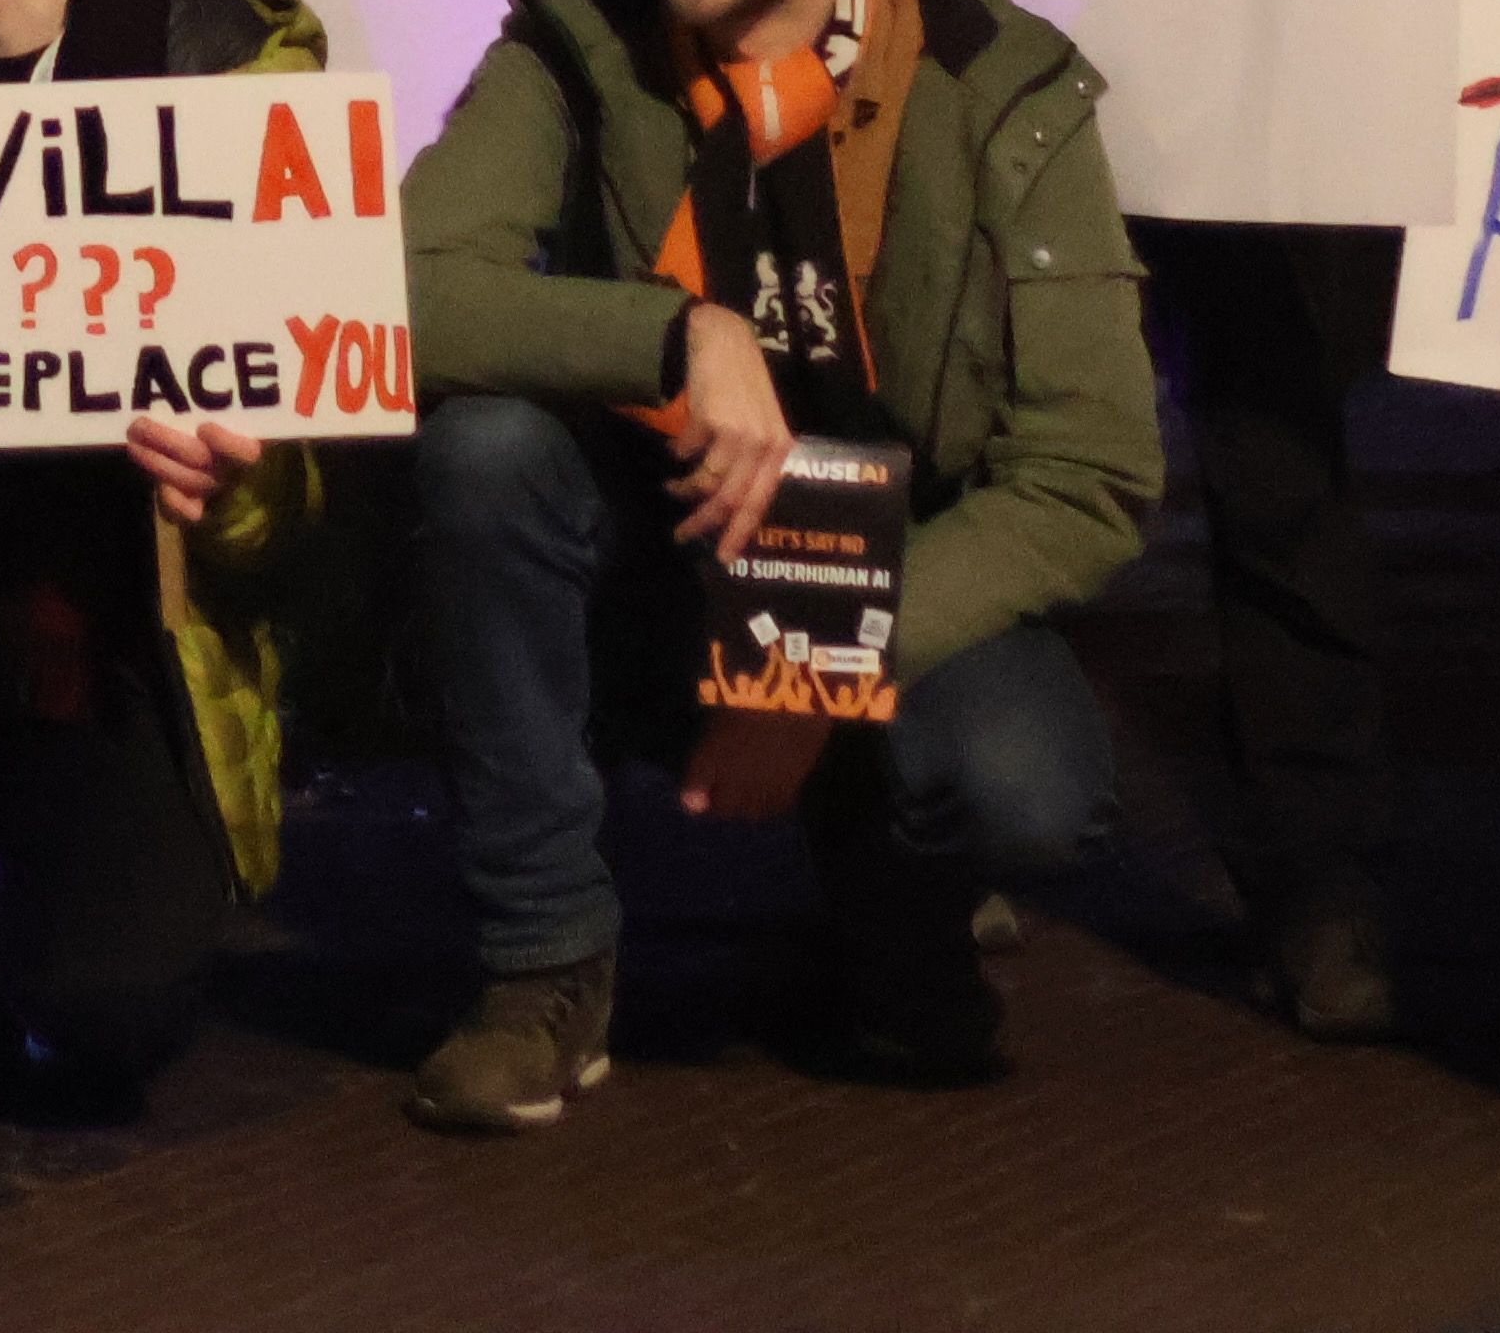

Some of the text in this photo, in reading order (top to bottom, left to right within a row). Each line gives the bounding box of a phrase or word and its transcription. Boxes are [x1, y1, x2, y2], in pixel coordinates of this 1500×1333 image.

[251, 100, 388, 224] AI
[12, 242, 177, 337] ???
[284, 314, 417, 421] YOU
[781, 459, 889, 485] AUSEAI
[751, 558, 869, 587] SUPERHUMAN
[872, 568, 891, 590] AI
